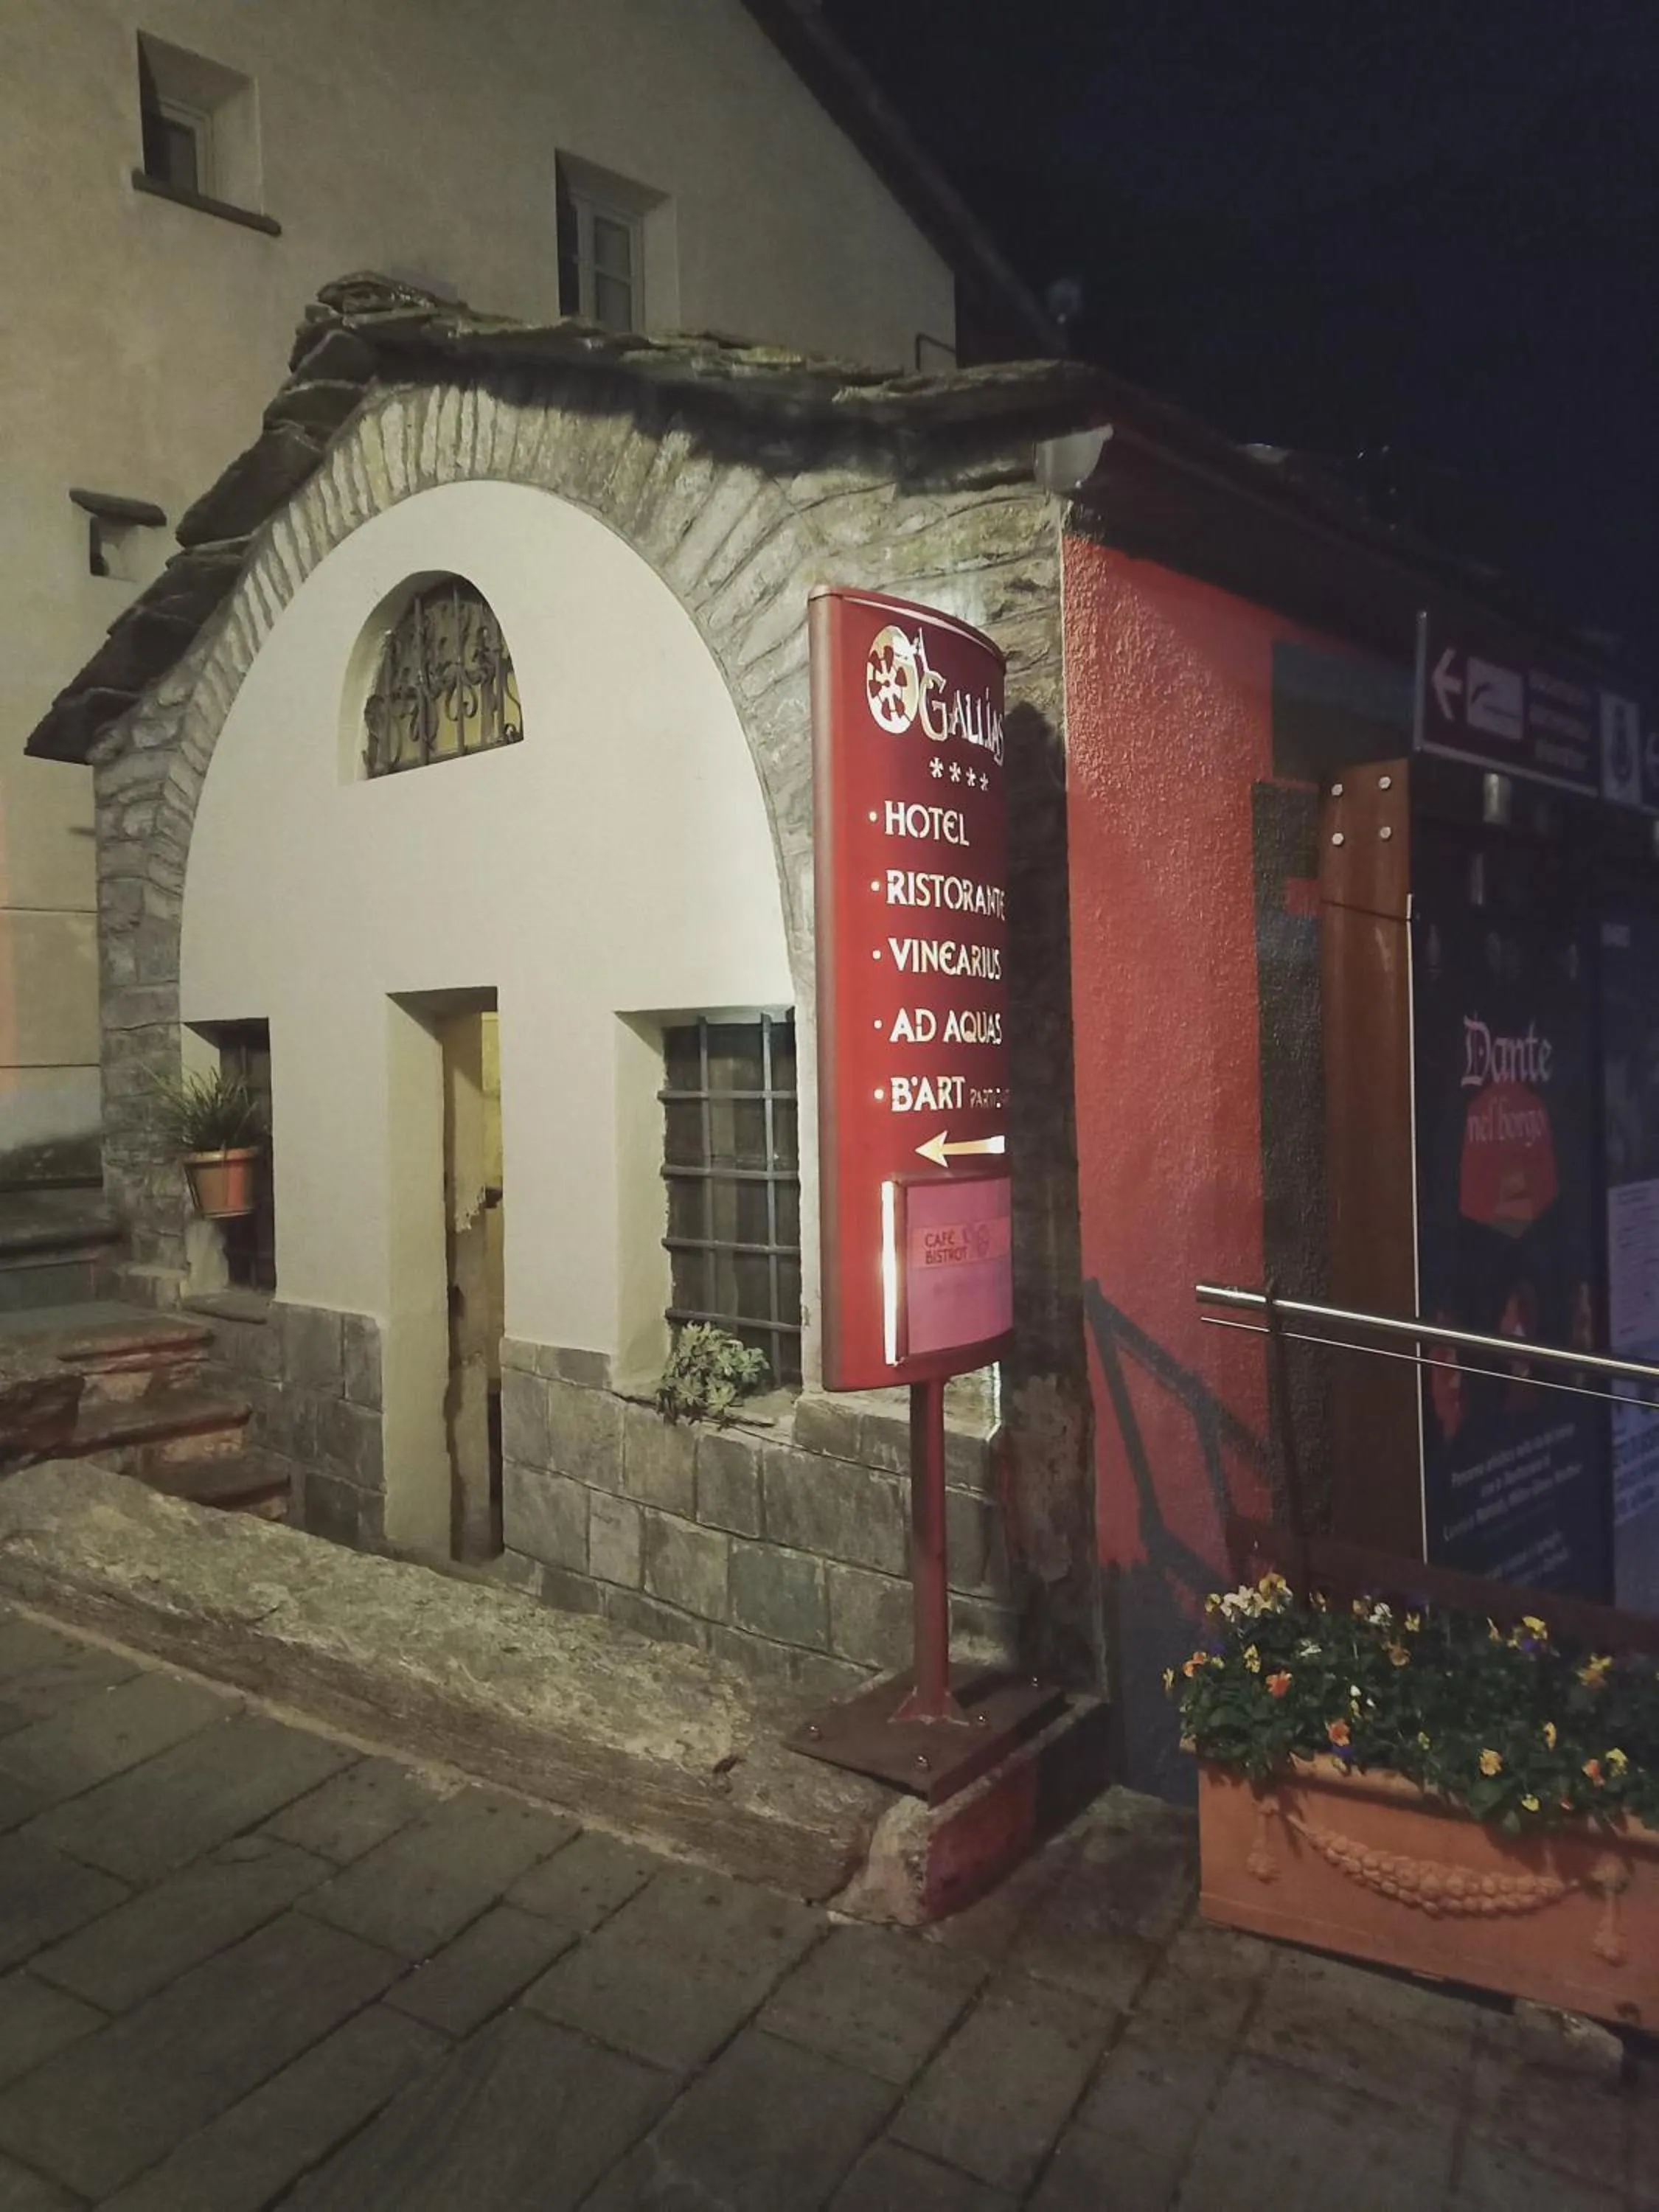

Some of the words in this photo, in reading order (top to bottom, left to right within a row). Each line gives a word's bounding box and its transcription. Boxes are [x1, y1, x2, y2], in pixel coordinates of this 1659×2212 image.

[885, 801, 970, 846] HOTEL
[886, 869, 1006, 921] RISTORANTE
[888, 937, 1002, 980] VINEARIUS
[889, 1007, 936, 1042] AD
[943, 1009, 1003, 1045] AQUAS
[1461, 1011, 1552, 1087] Dante
[891, 1076, 966, 1112] B'ART
[925, 1246, 967, 1265] BISTROT
